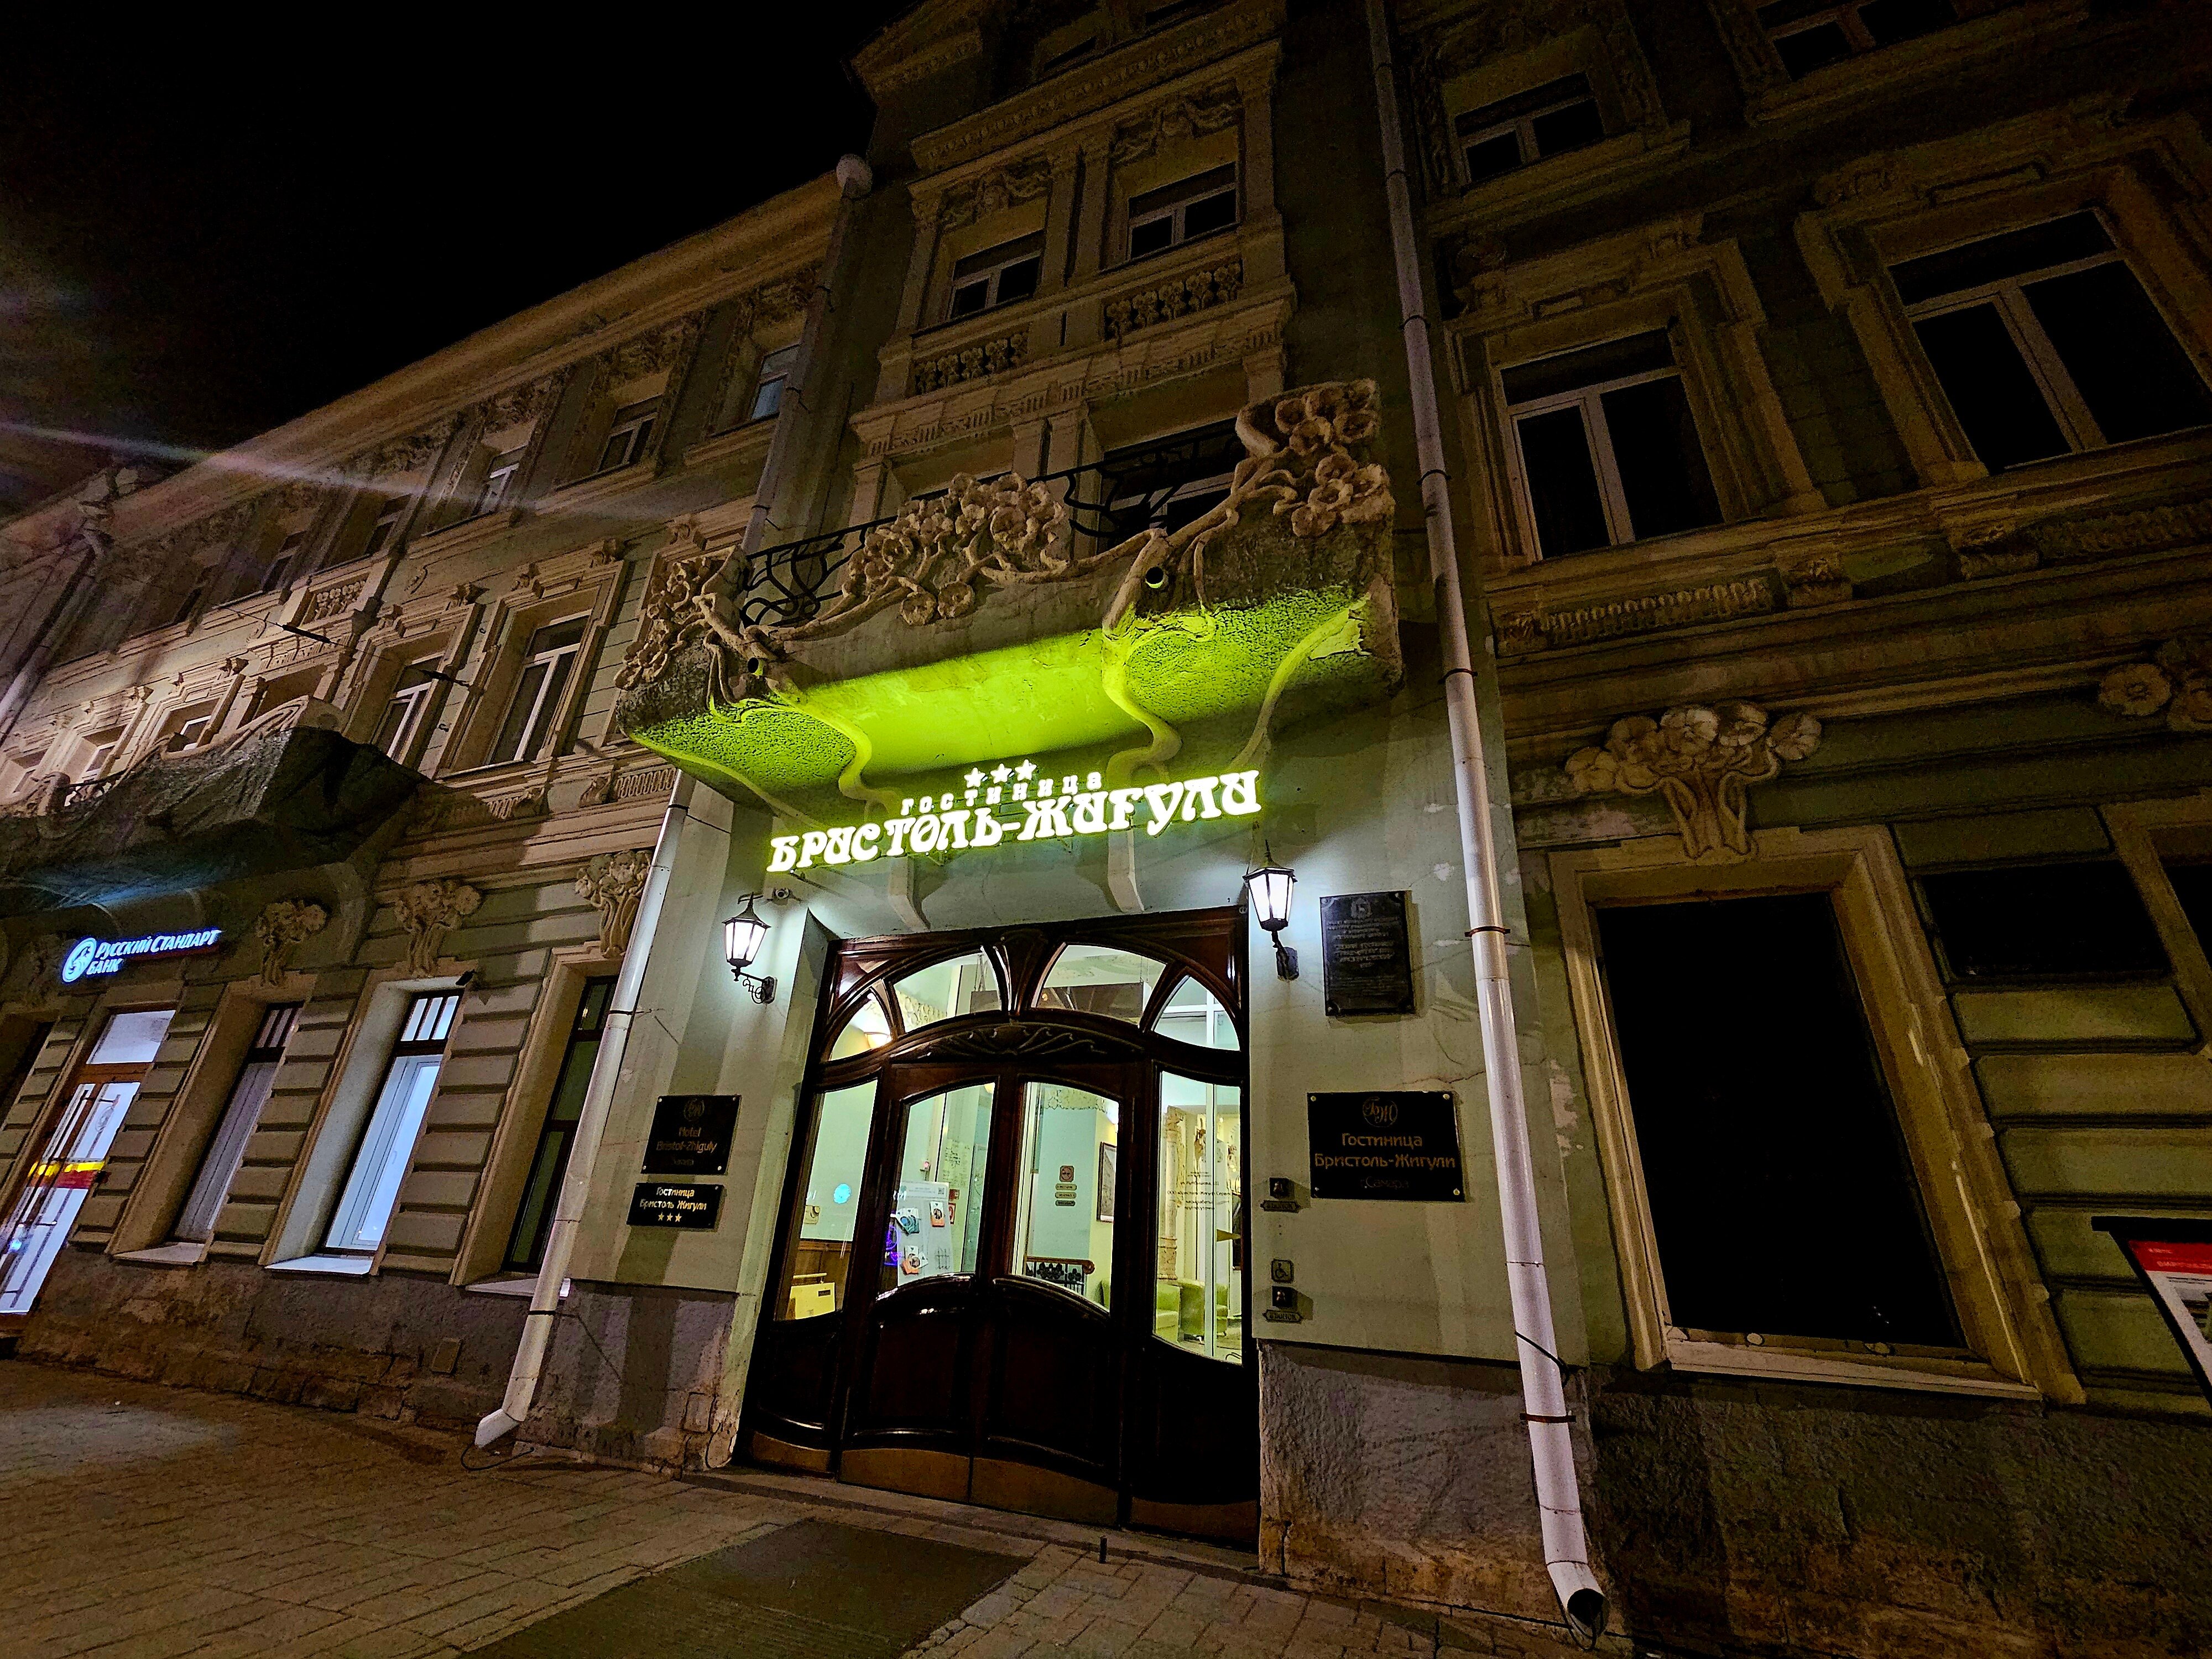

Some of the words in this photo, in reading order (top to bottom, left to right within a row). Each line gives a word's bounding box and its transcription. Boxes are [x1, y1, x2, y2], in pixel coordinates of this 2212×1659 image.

[766, 769, 1262, 873] БРИСТОЛЬ-ЖИГУЛИ
[87, 958, 123, 974] БАНК
[1342, 1133, 1423, 1150] Гостиница
[1314, 1152, 1455, 1171] Бристоль-Жигули
[656, 1187, 695, 1199] Гостиница
[676, 1200, 707, 1212] Жигули
